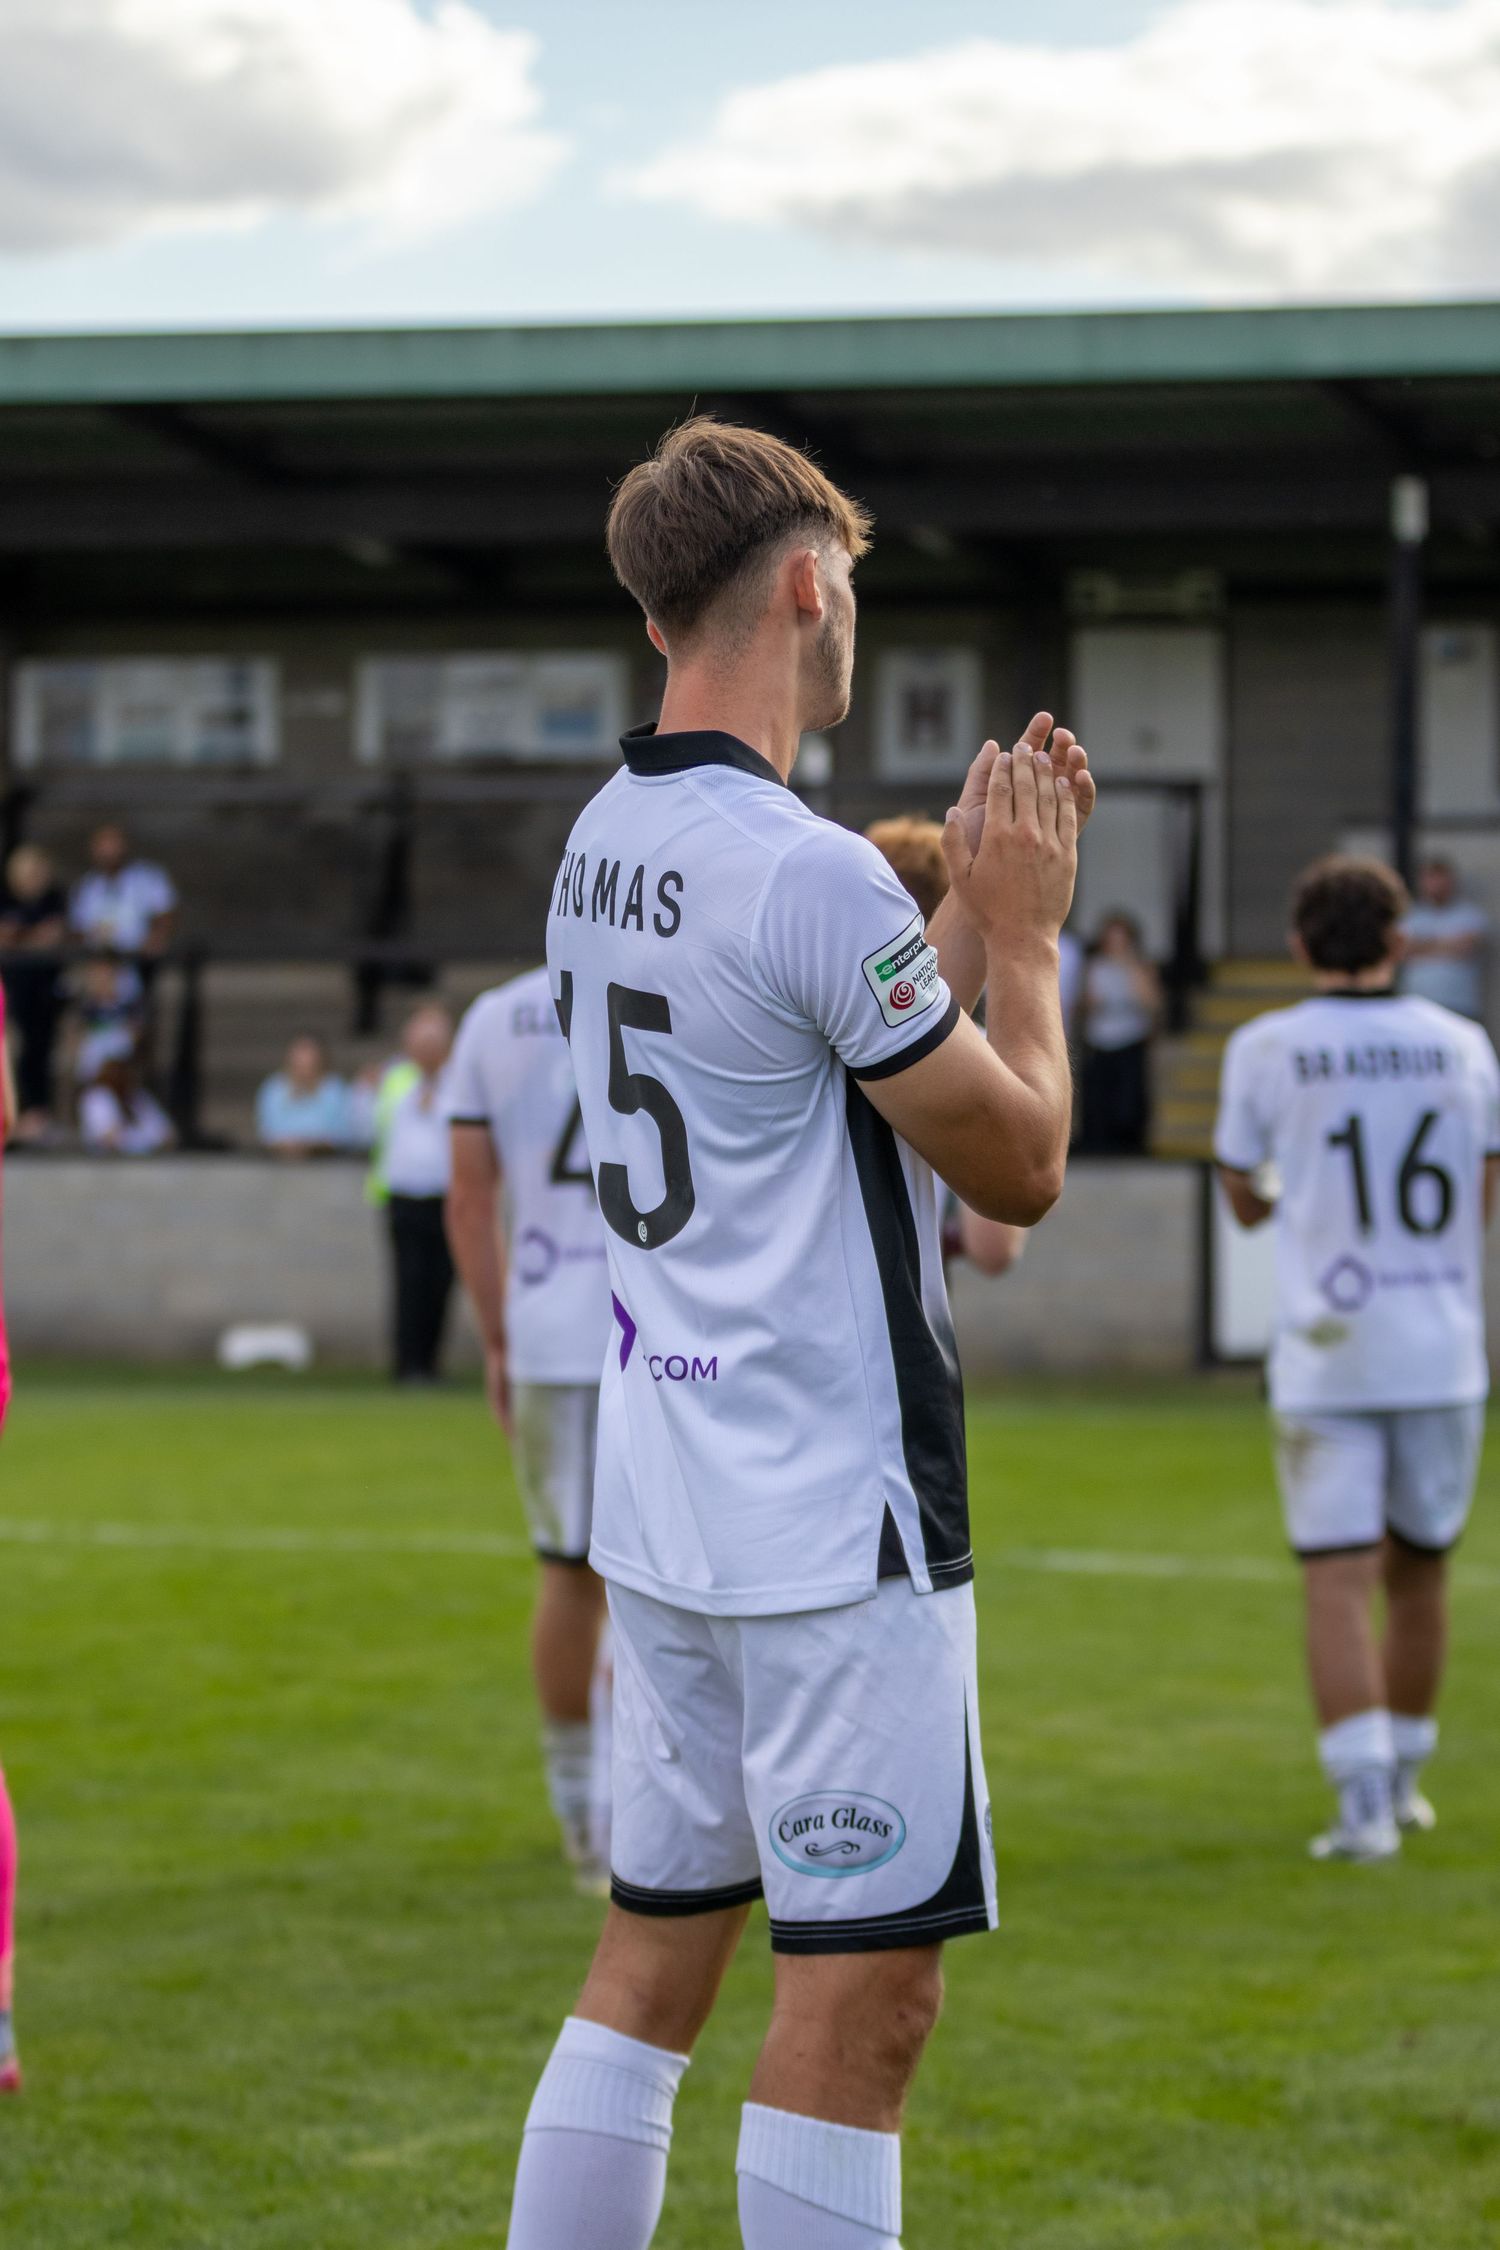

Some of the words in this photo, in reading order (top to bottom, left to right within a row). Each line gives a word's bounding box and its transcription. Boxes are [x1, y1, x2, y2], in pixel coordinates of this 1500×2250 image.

[1328, 1111, 1455, 1240] 16
[778, 1814, 825, 1843] Cara
[831, 1807, 893, 1838] Glass
